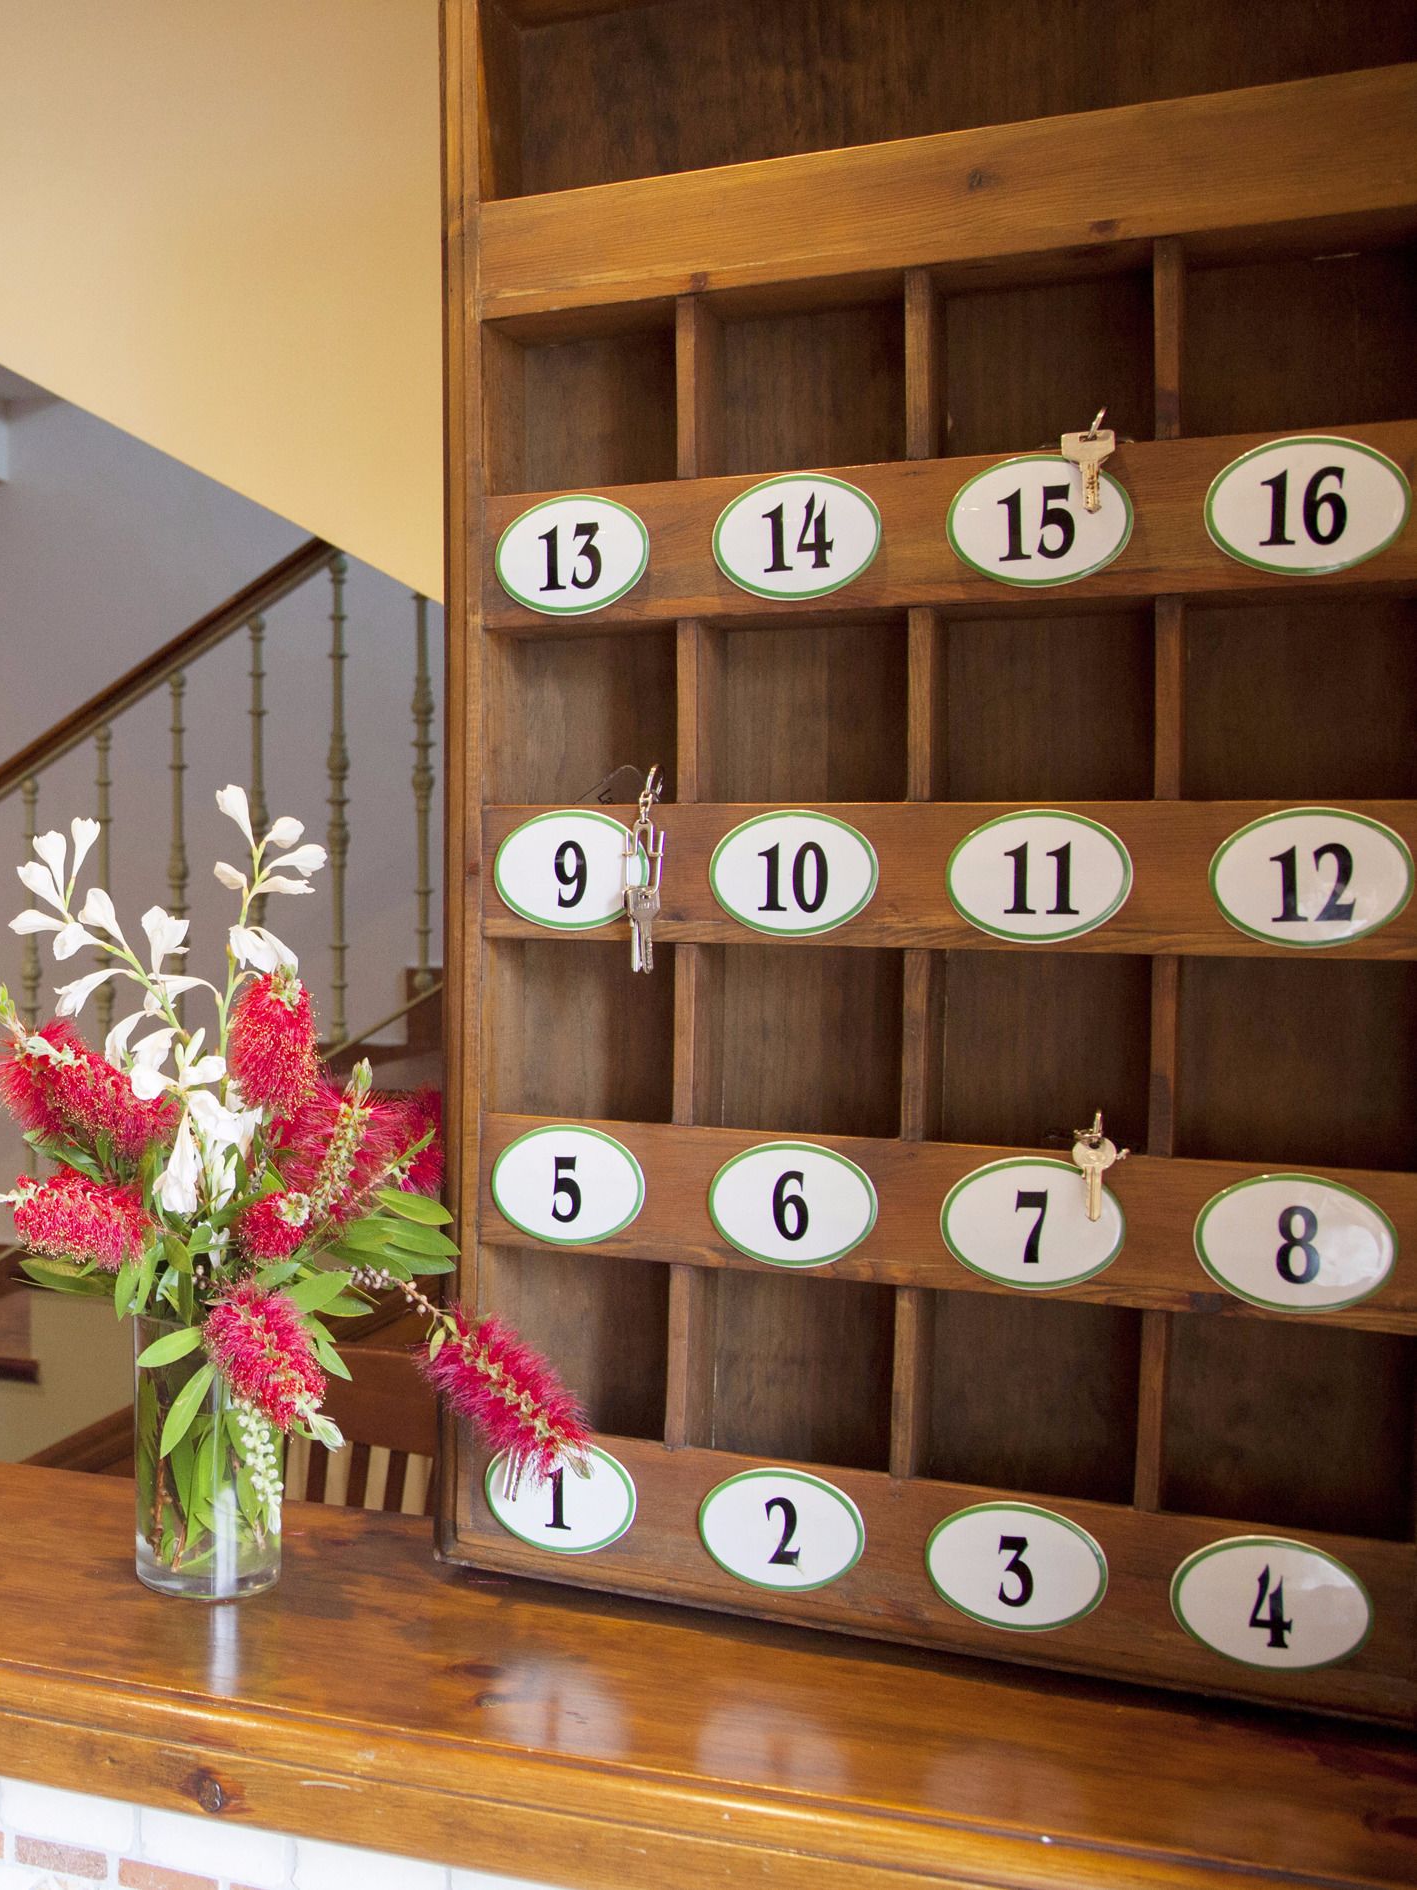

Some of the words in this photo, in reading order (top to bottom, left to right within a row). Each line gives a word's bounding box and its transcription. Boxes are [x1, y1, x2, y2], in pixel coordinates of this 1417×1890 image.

[761, 492, 834, 573] 14
[997, 483, 1075, 562] 15
[1259, 466, 1348, 547] 16
[538, 522, 602, 592] 13
[554, 840, 587, 908] 9
[757, 841, 828, 914] 10
[1003, 841, 1080, 915] 11
[1269, 842, 1355, 923] 12
[551, 1156, 582, 1223] 5
[772, 1170, 809, 1242] 6
[1015, 1190, 1048, 1264] 7
[1276, 1205, 1318, 1285] 8
[545, 1467, 571, 1531] 1
[764, 1497, 800, 1566] 2
[998, 1535, 1034, 1608] 3
[1248, 1565, 1293, 1650] 4
